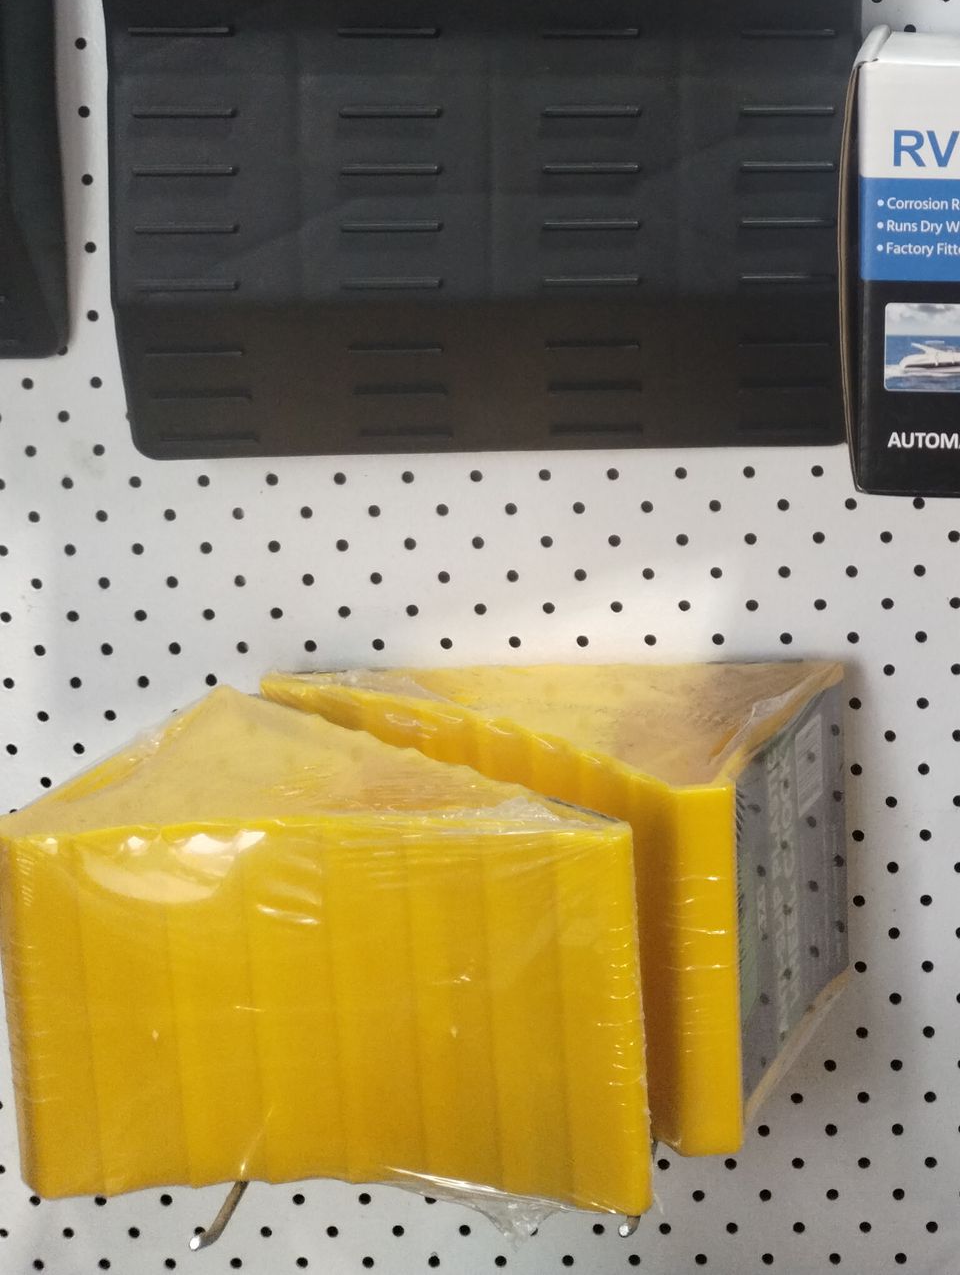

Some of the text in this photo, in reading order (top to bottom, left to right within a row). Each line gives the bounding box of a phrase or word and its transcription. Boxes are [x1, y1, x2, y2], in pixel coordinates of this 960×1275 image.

[894, 130, 959, 167] RV
[887, 197, 948, 210] Corrosion
[887, 220, 917, 232] Runs
[921, 220, 943, 235] Dry
[887, 242, 934, 257] Factory
